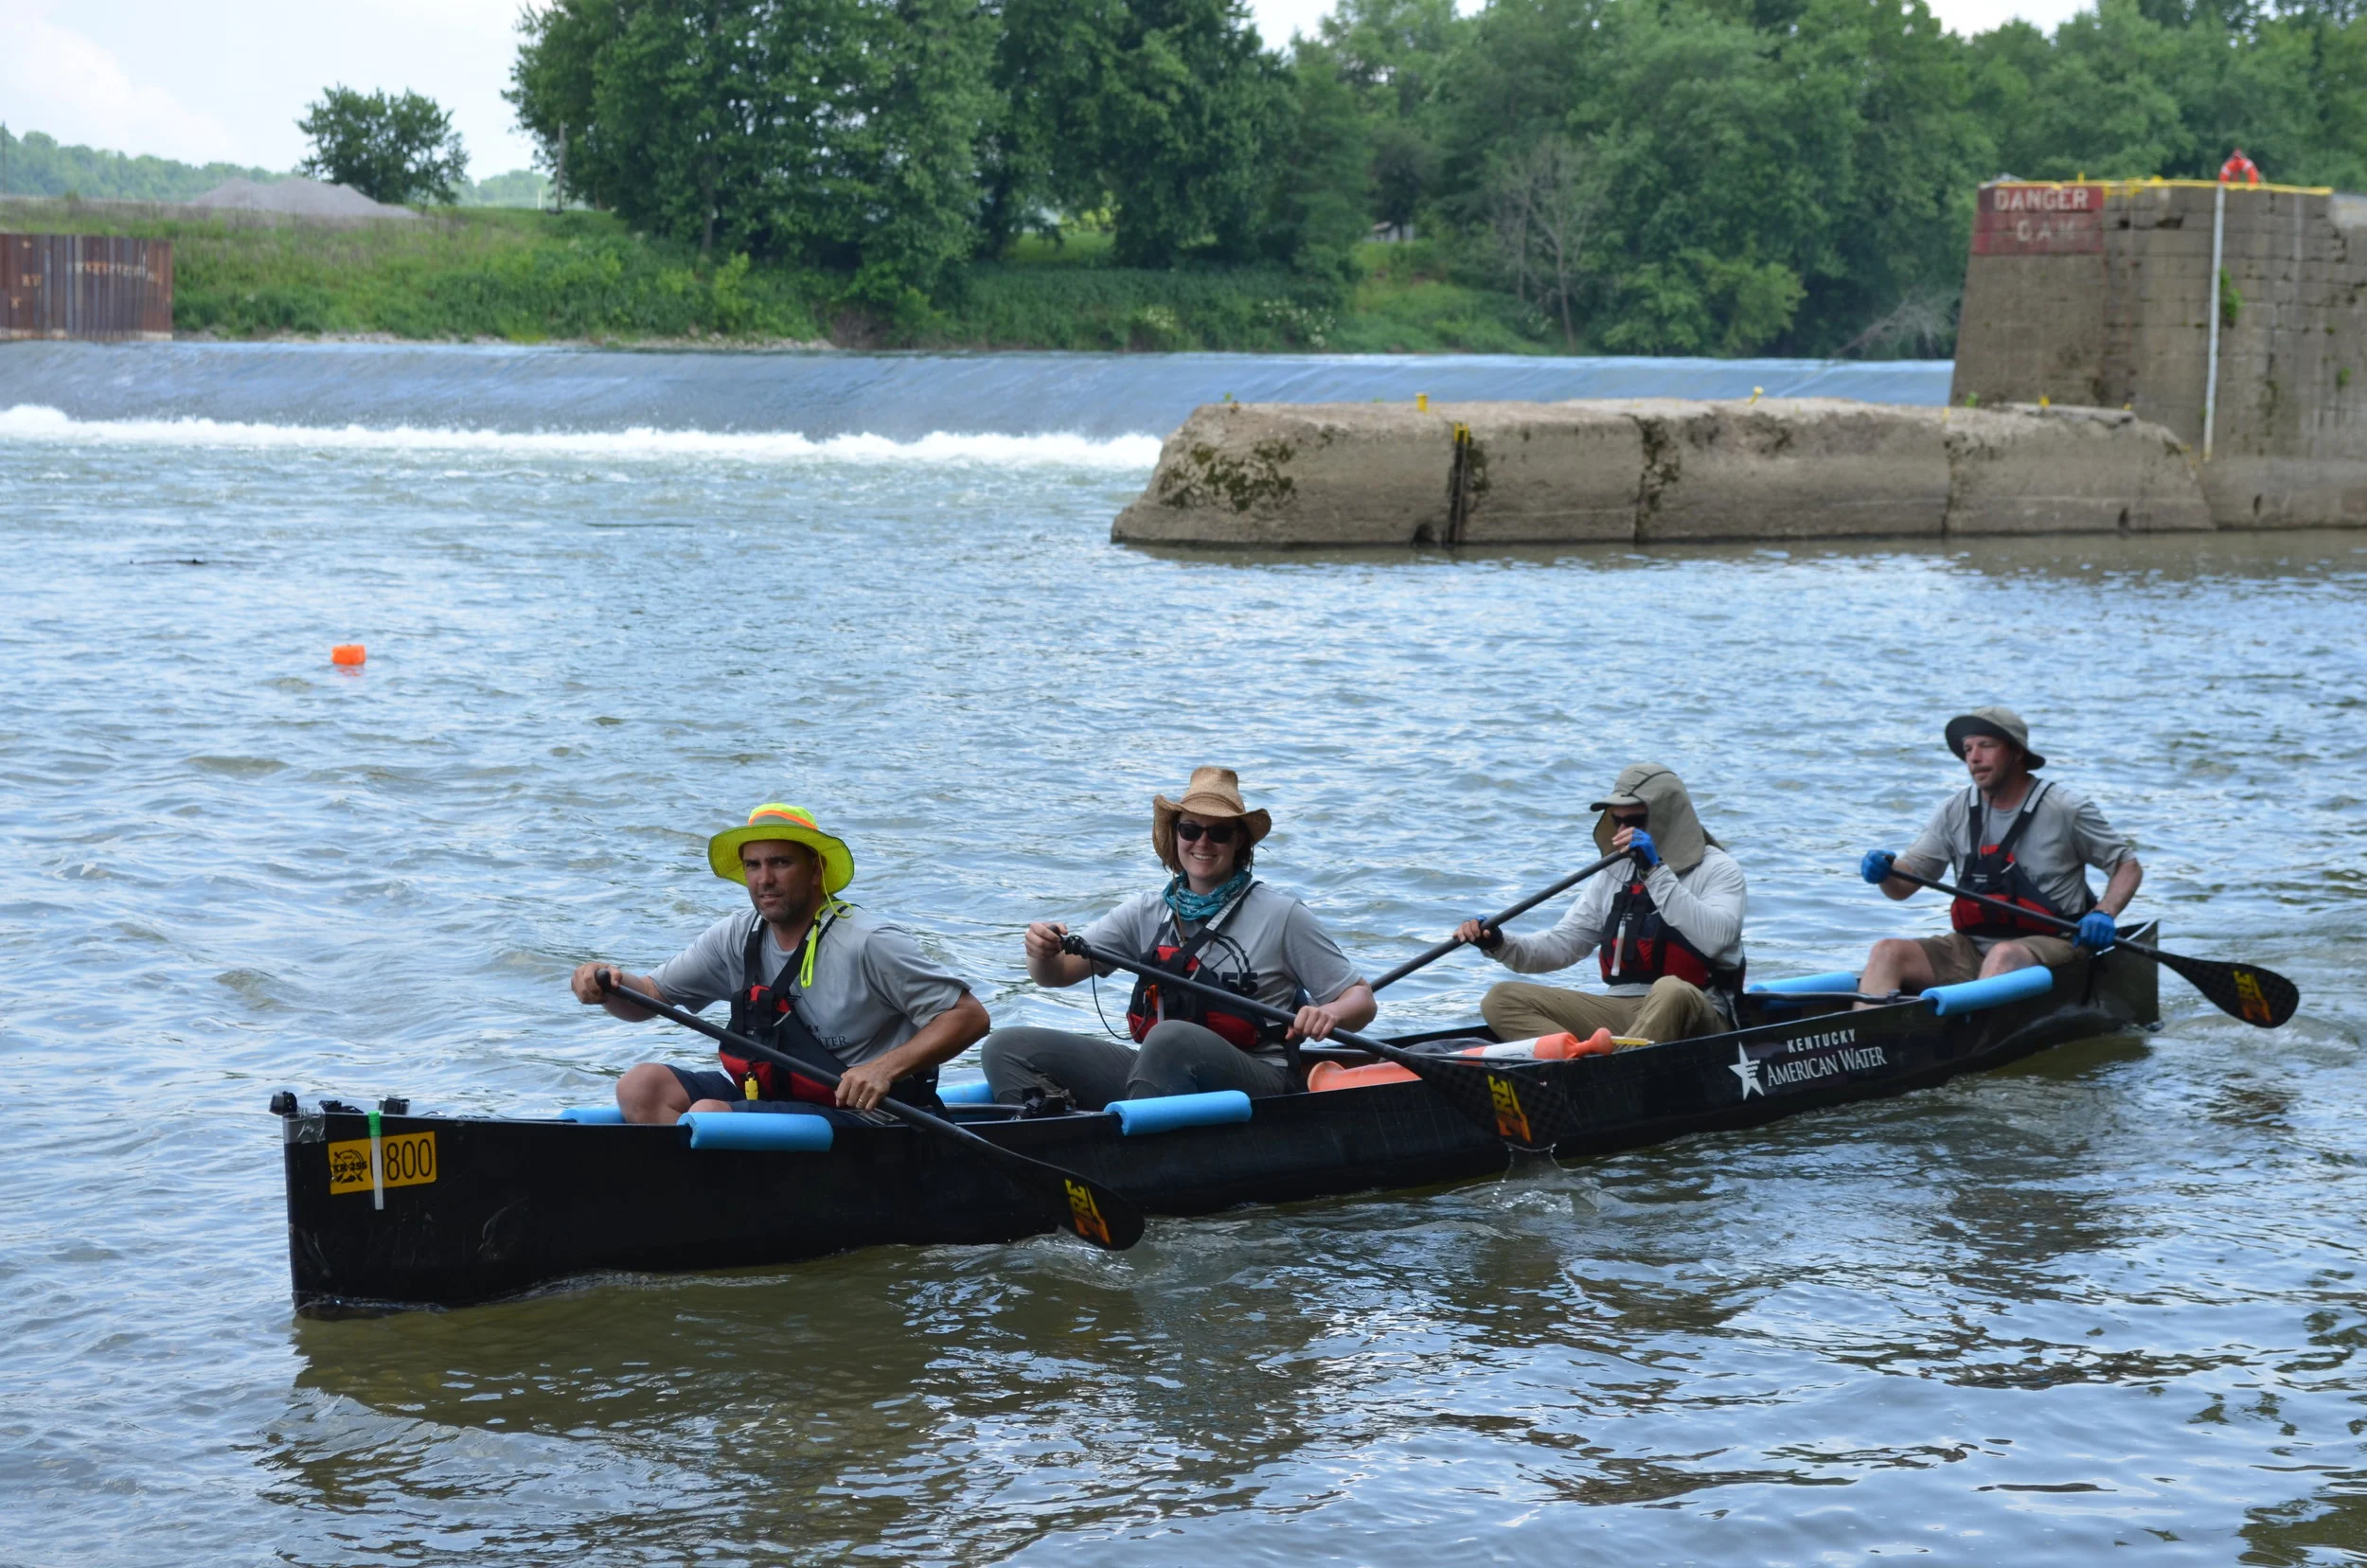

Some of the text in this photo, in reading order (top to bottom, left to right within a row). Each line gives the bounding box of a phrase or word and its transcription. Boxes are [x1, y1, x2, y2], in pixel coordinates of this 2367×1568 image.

[1994, 187, 2089, 210] DANGER
[1212, 971, 1258, 995] 55
[1787, 1028, 1856, 1053] KENTUCKY
[1767, 1046, 1888, 1087] AMERICAN WATER
